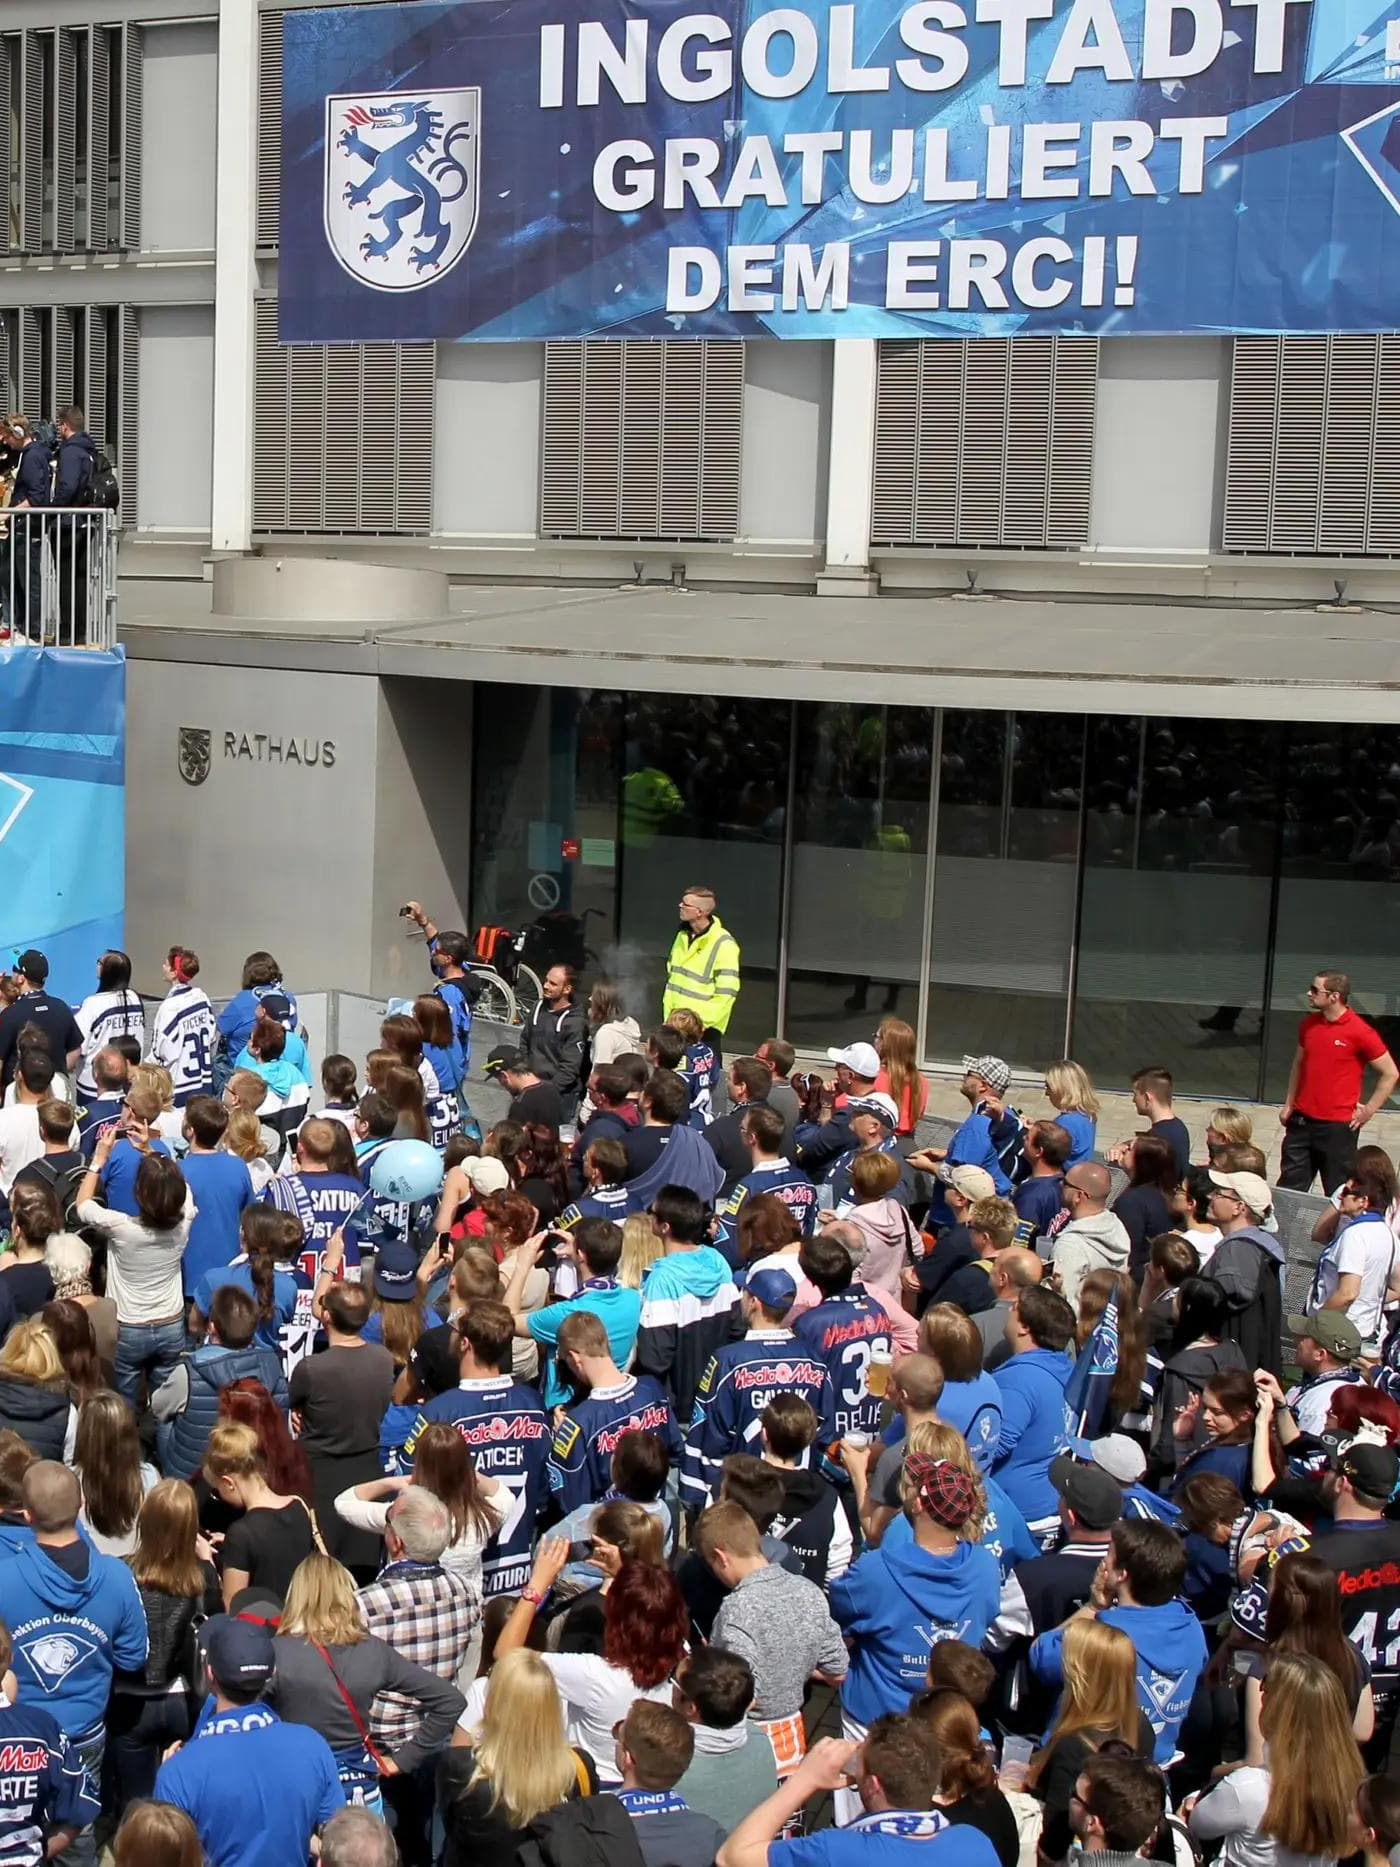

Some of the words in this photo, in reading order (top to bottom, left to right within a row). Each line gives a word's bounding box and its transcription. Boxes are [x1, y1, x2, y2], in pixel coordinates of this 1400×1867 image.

[538, 0, 1314, 109] INGOLSTADT
[591, 116, 1228, 212] GRATULIERT
[665, 242, 850, 313] DEM
[885, 234, 1140, 311] ERCI!
[223, 731, 336, 767] RATHAUS
